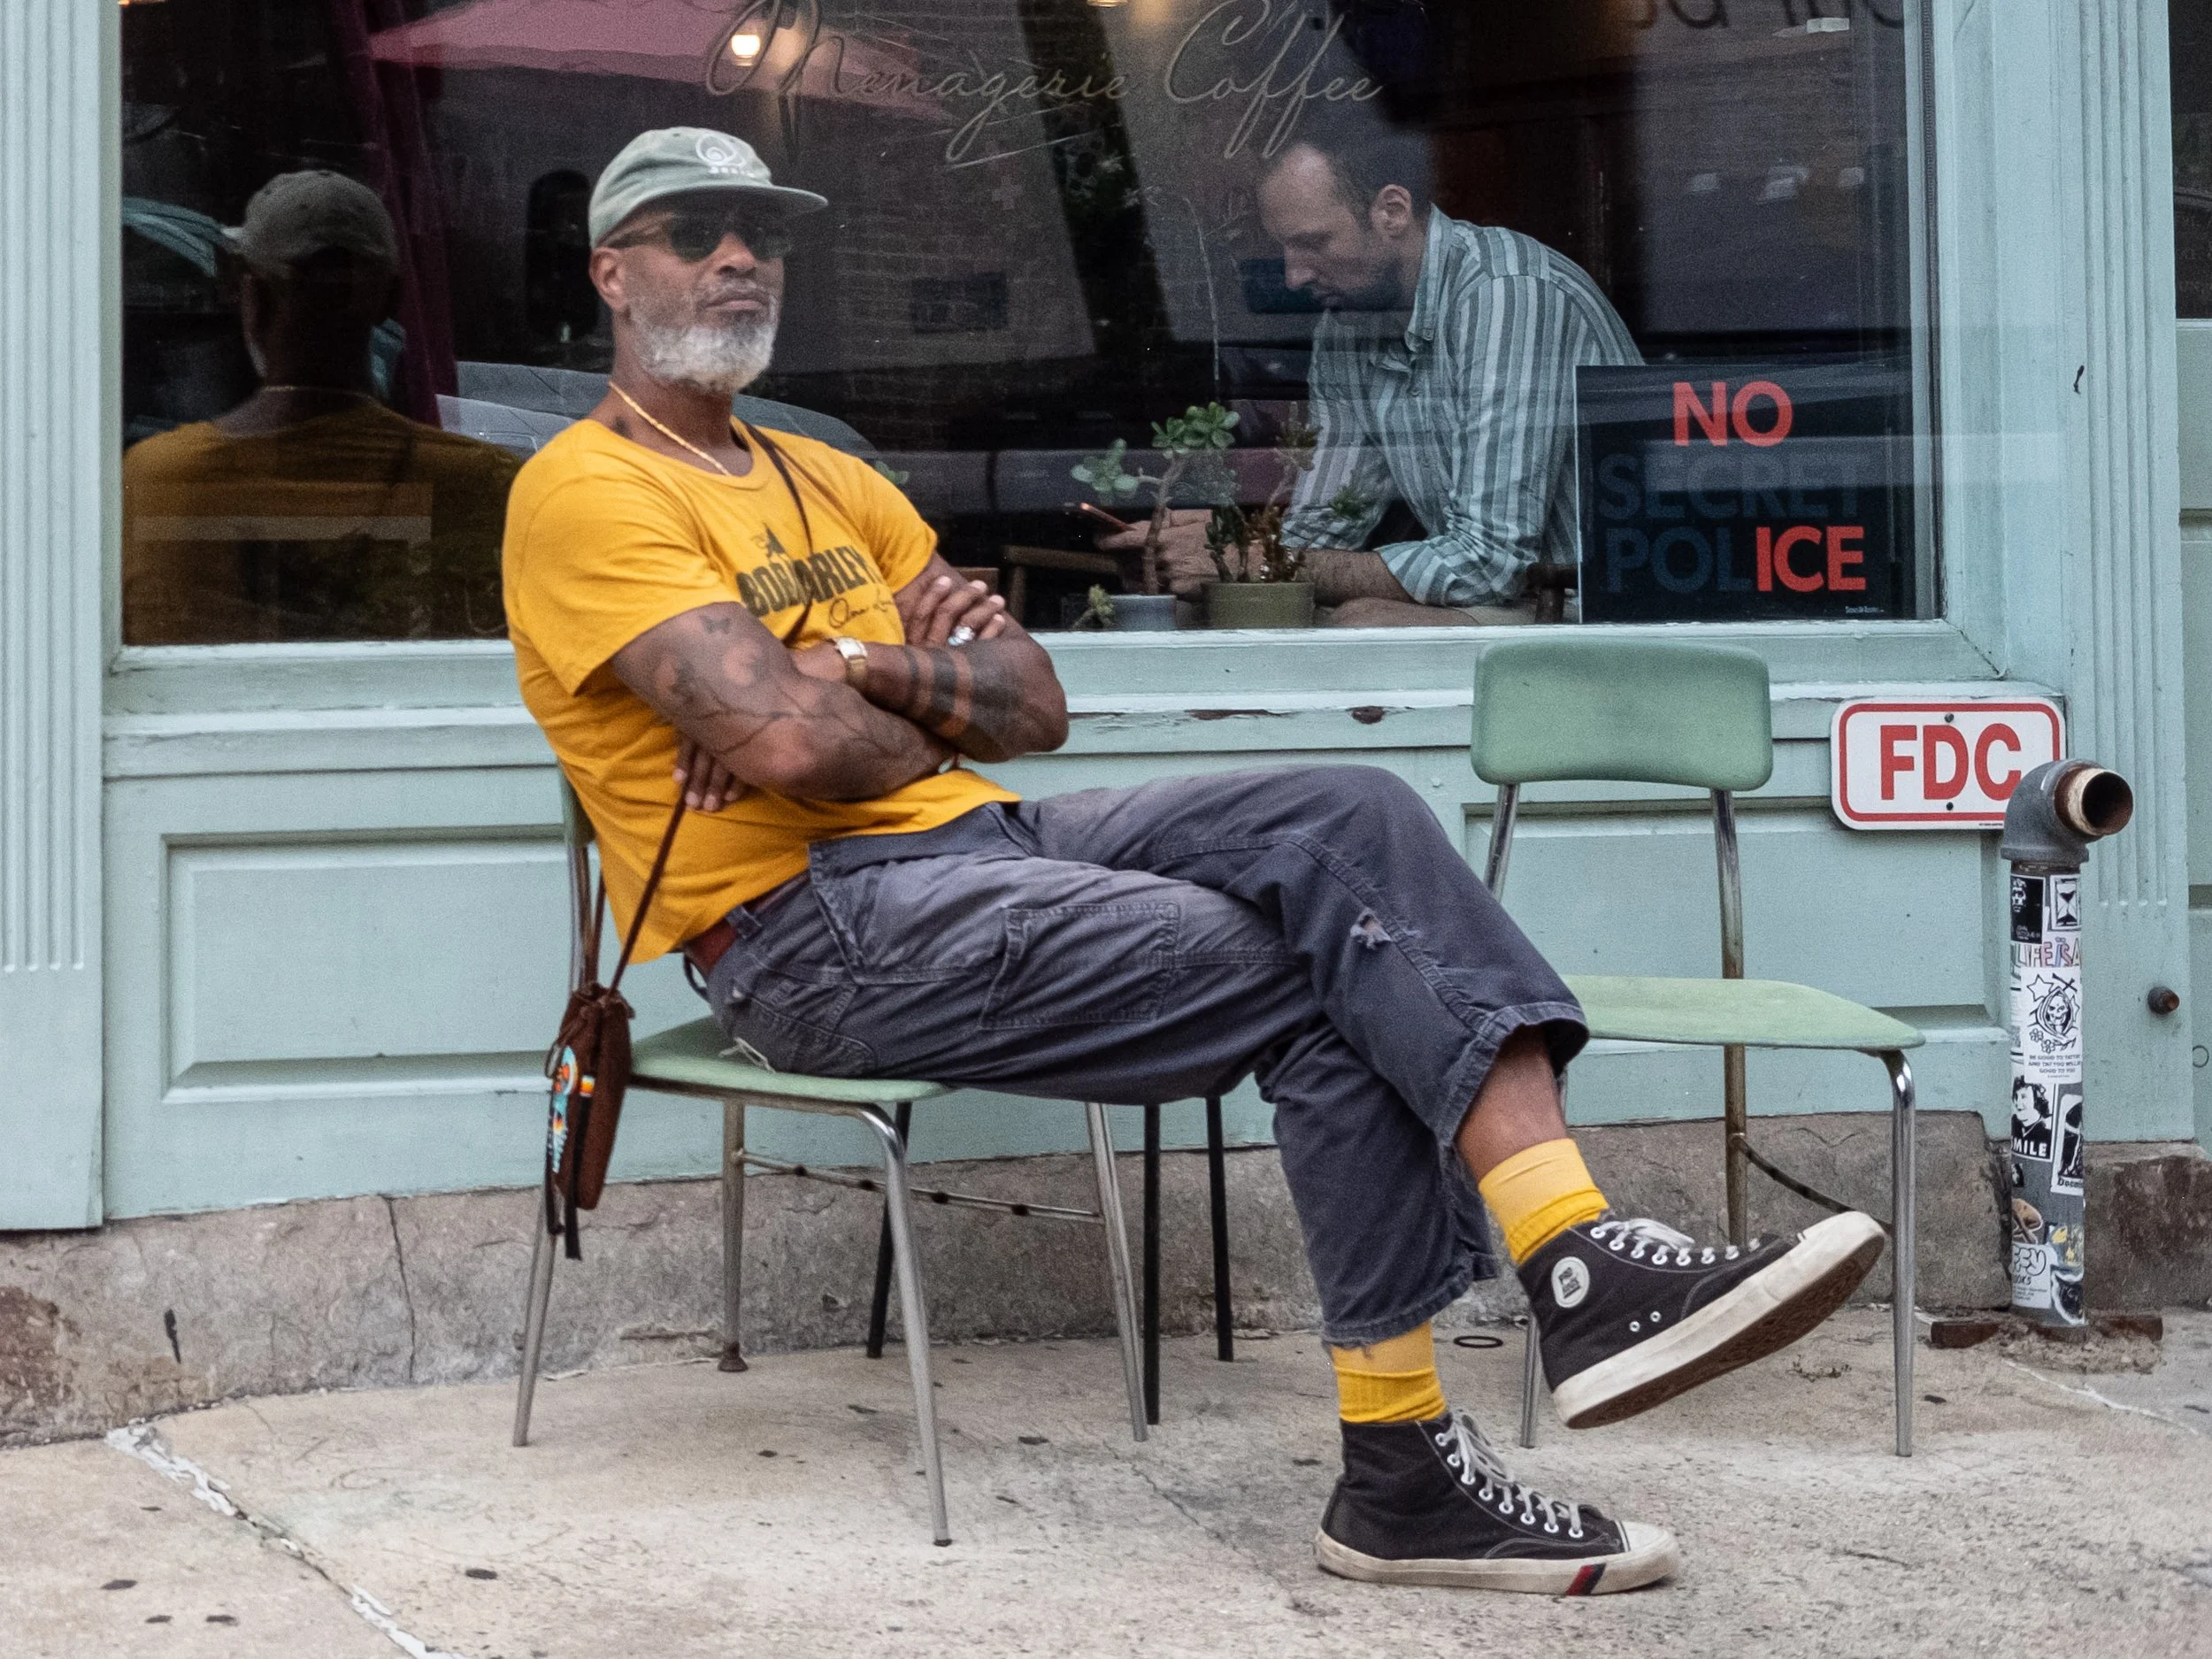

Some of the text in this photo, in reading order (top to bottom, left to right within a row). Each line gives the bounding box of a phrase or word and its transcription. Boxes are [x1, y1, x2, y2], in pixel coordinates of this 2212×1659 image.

[1164, 0, 1385, 159] Coffee
[1671, 380, 1794, 448] NO
[1595, 452, 1861, 520] SECRET
[1603, 524, 1868, 594] POLICE
[1879, 722, 2023, 801] FDC
[2011, 1136, 2048, 1157] MILE
